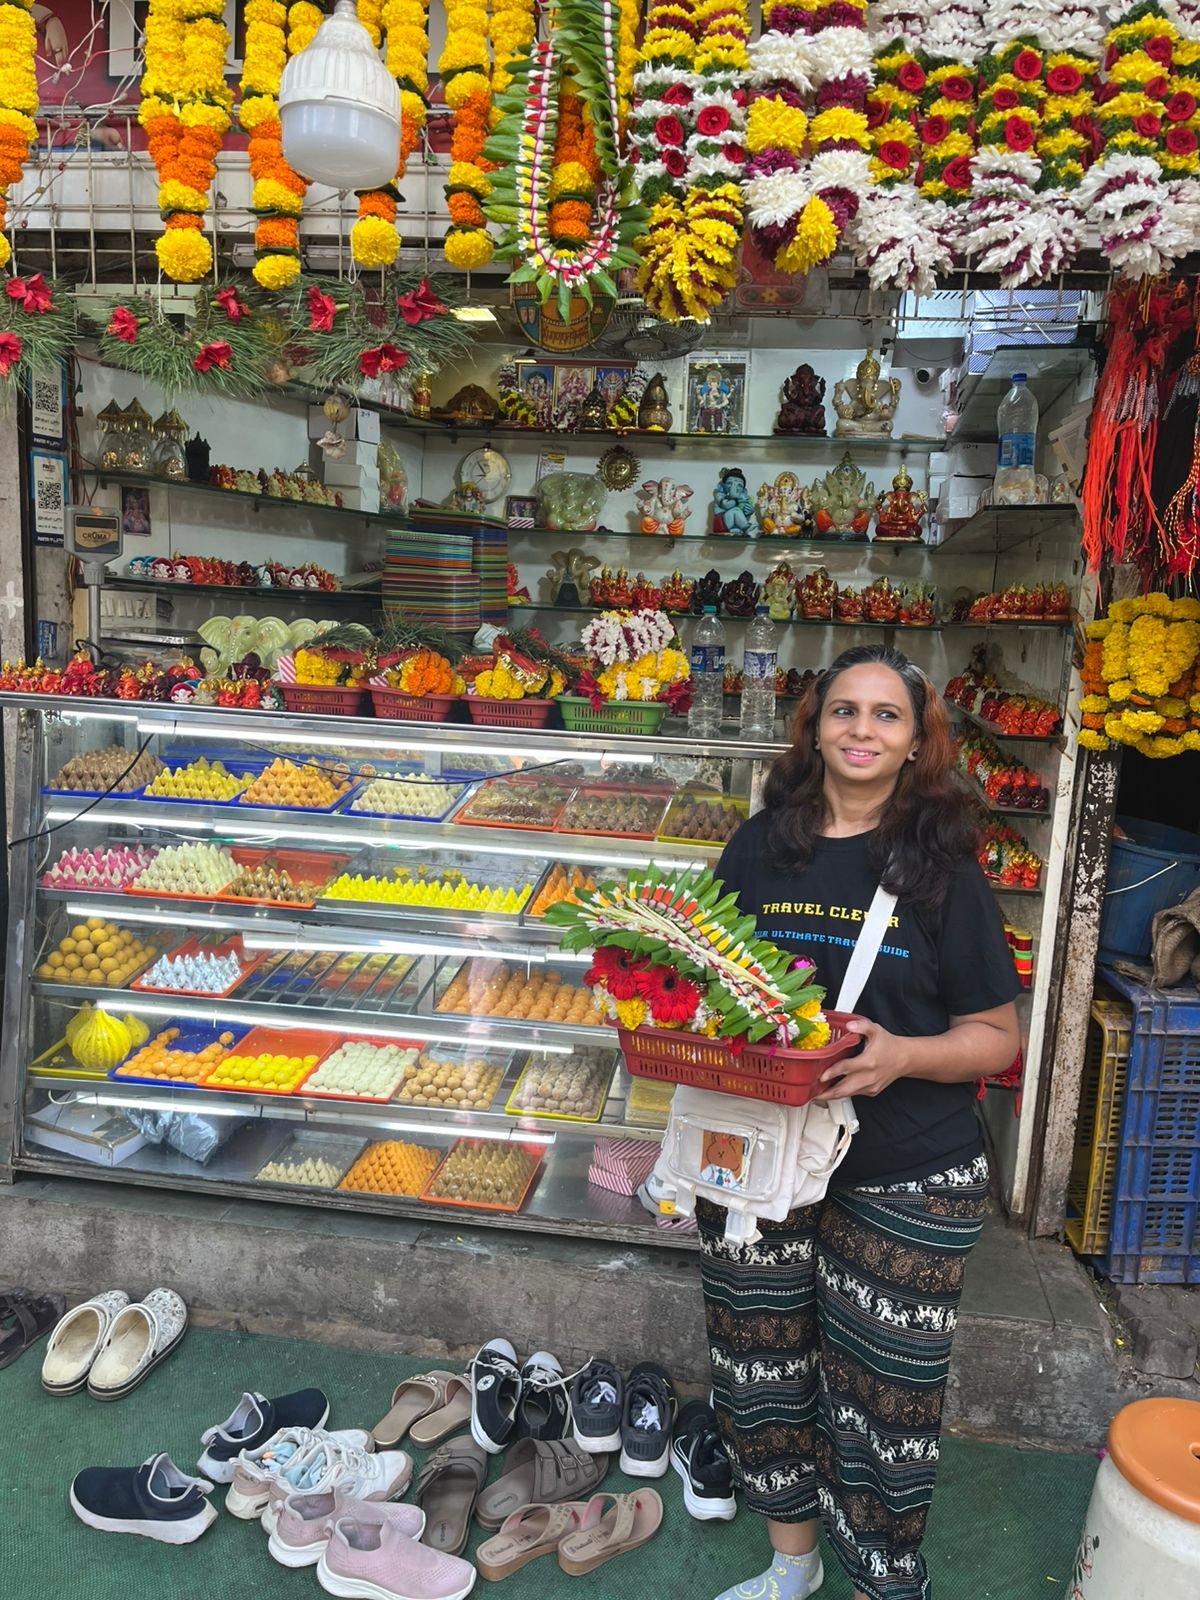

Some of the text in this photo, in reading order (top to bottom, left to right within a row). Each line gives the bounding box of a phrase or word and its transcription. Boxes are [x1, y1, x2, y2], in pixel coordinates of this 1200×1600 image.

[82, 532, 108, 540] CROMA
[762, 902, 900, 928] TRAVEL CLEVR
[771, 930, 826, 943] ULTIMATE
[827, 935, 858, 947] TRAV
